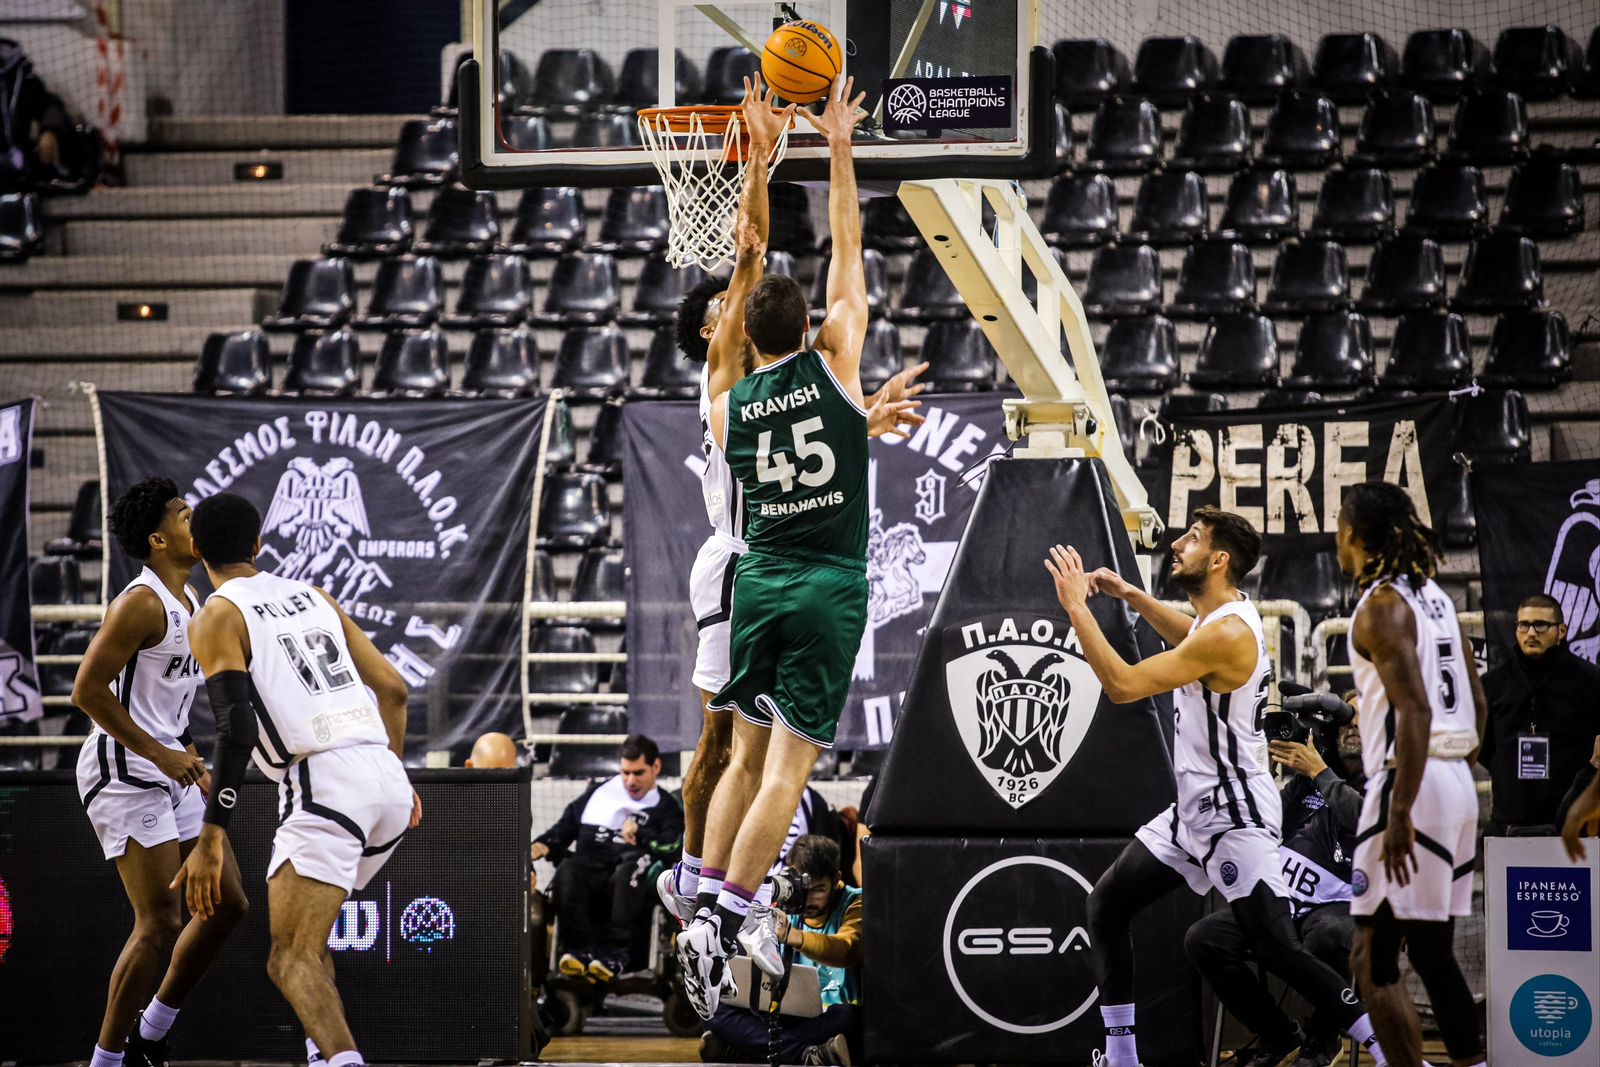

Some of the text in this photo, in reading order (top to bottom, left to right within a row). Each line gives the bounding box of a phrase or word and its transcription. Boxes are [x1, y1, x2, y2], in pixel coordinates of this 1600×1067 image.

[929, 87, 997, 98] BASKETBALL
[929, 97, 1006, 108] CHAMPIONS
[929, 109, 970, 118] LEAGUE
[741, 383, 821, 422] KRAVISH
[756, 416, 836, 492] 45
[760, 491, 844, 516] BENAHAVÍS
[358, 540, 436, 558] EMPERORS
[277, 626, 356, 698] 12
[1435, 636, 1460, 714] 5
[997, 776, 1039, 791] 1926
[1008, 793, 1026, 803] BC
[1519, 881, 1577, 891] IPANEMA
[1517, 891, 1579, 901] ESPRESSO
[957, 926, 1091, 955] GSA
[1109, 1027, 1131, 1036] GSA
[1530, 1028, 1571, 1040] utopia
